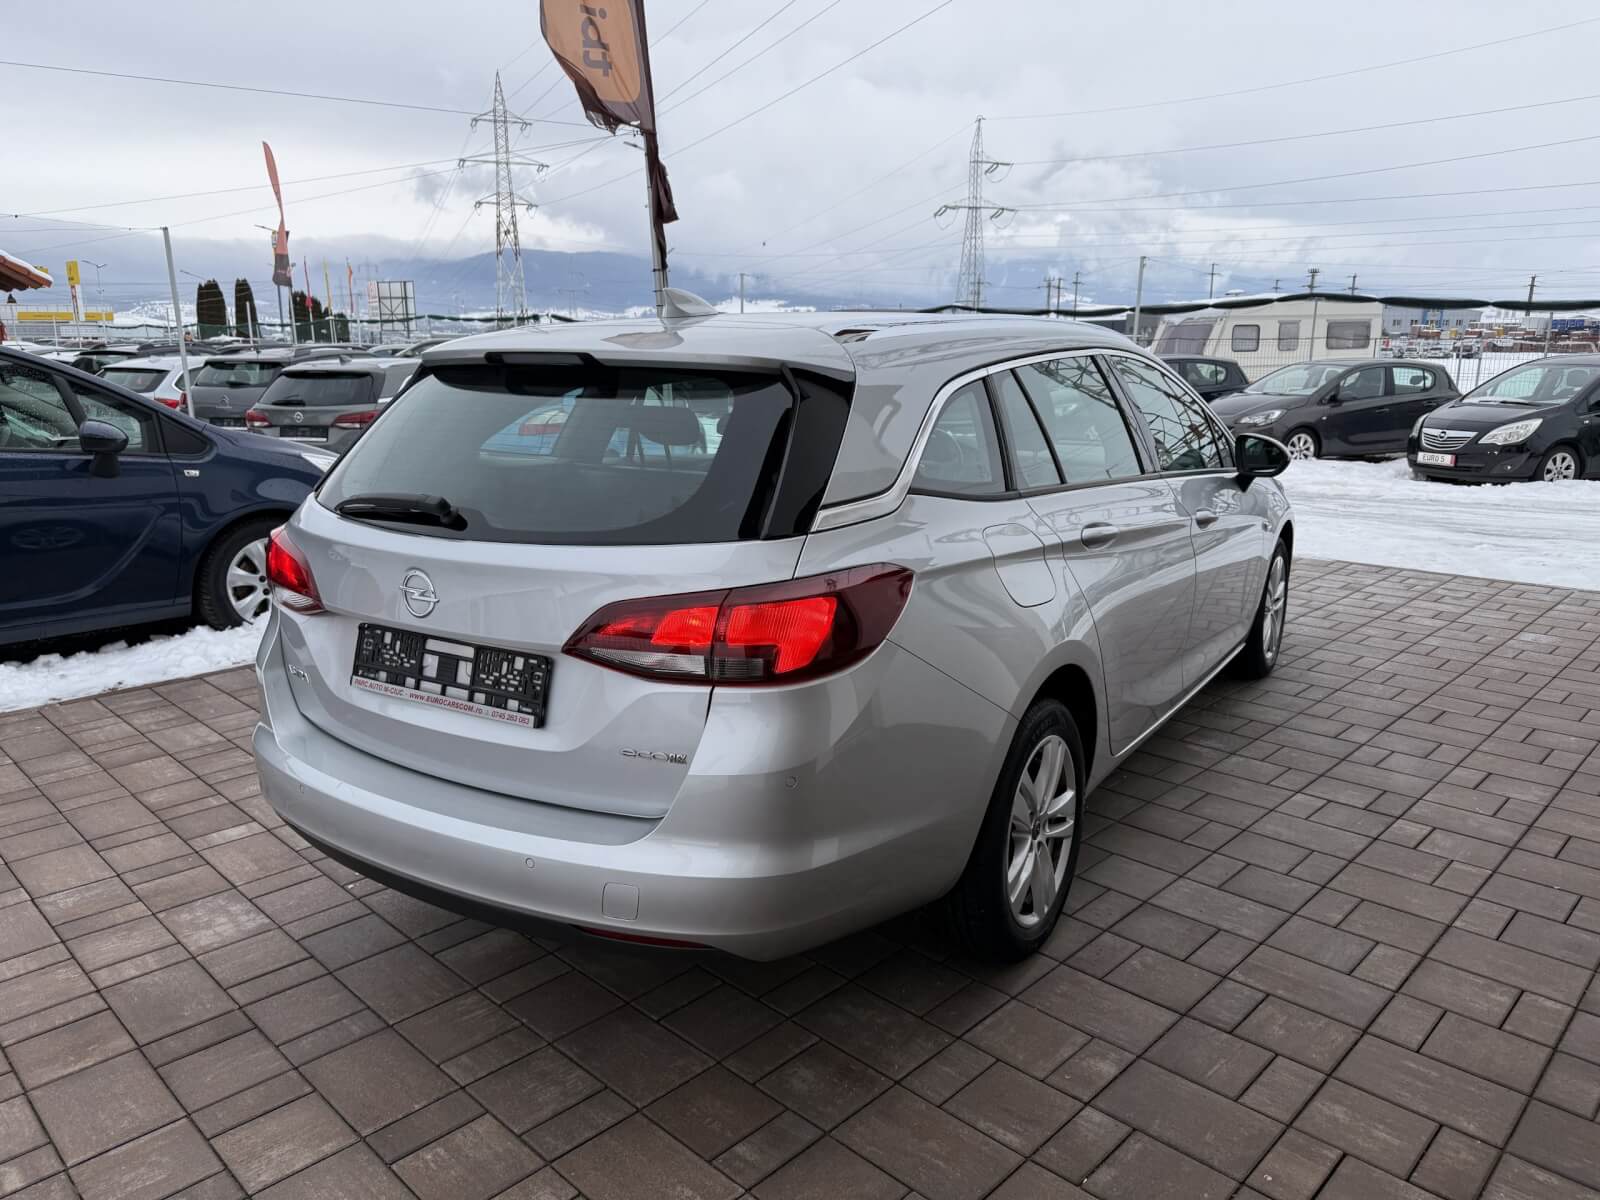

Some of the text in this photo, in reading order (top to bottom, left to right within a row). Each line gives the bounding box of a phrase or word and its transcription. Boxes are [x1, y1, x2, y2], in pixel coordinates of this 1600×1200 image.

[1423, 455, 1440, 463] EURO
[354, 678, 369, 688] PARC
[369, 680, 383, 690] AUTO
